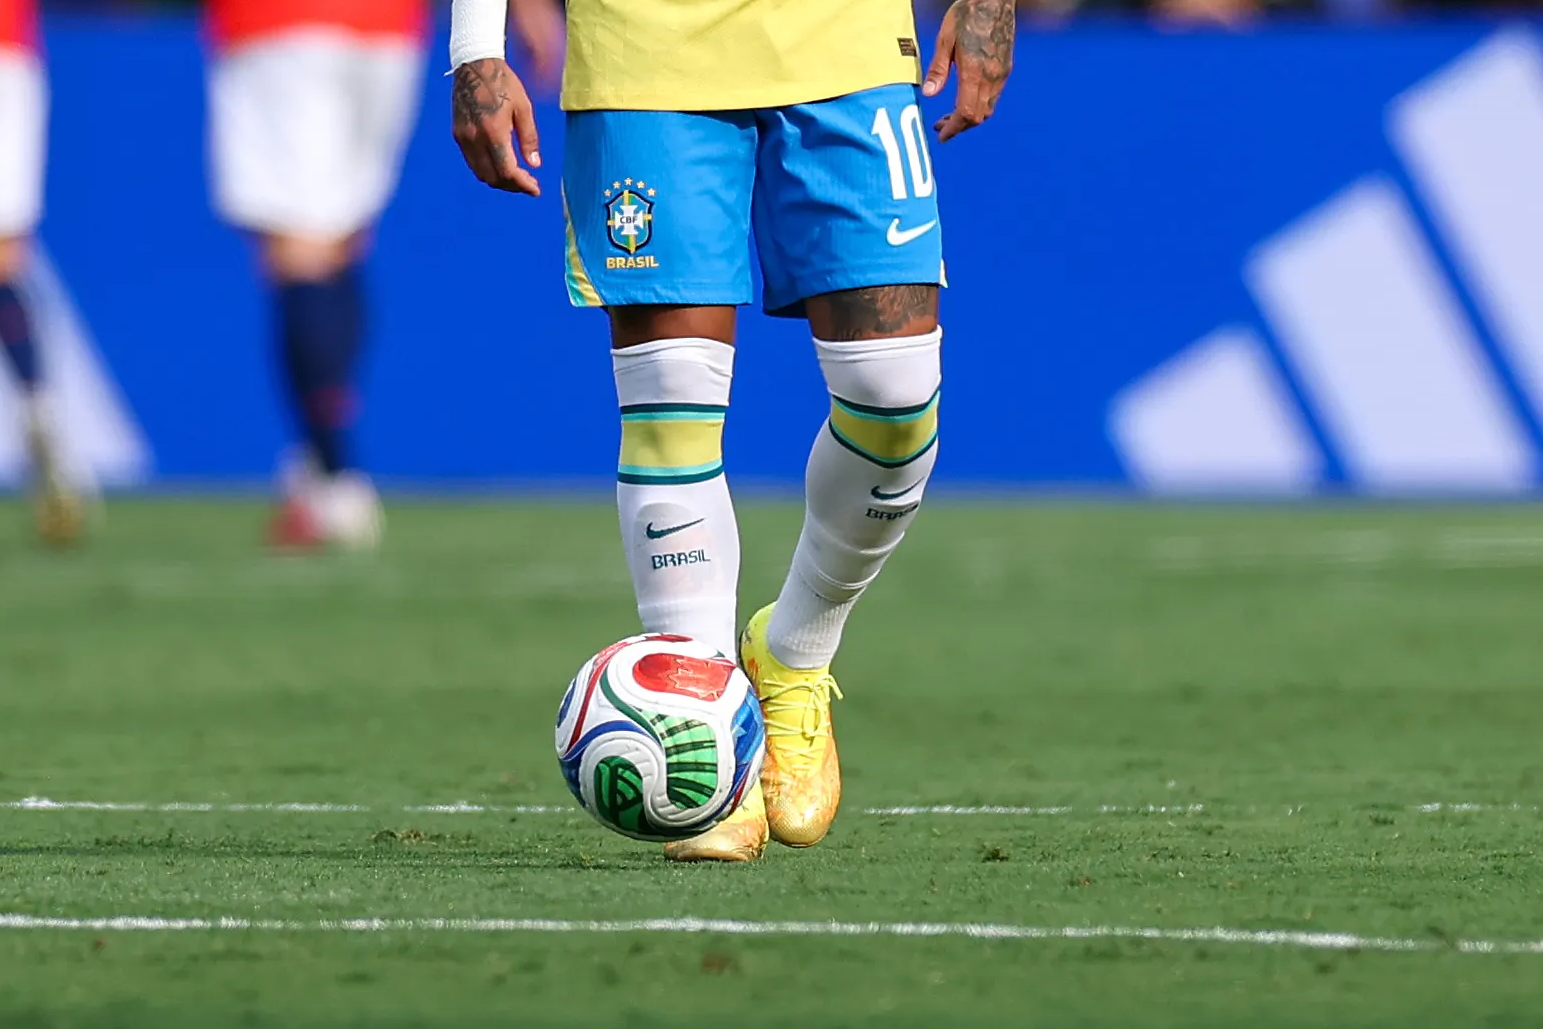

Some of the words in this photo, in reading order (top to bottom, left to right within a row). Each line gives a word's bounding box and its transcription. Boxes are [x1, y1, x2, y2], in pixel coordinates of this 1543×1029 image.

[871, 103, 933, 200] 10
[619, 215, 638, 224] CBF
[606, 256, 660, 269] BRASIL
[651, 549, 711, 570] BRASIL
